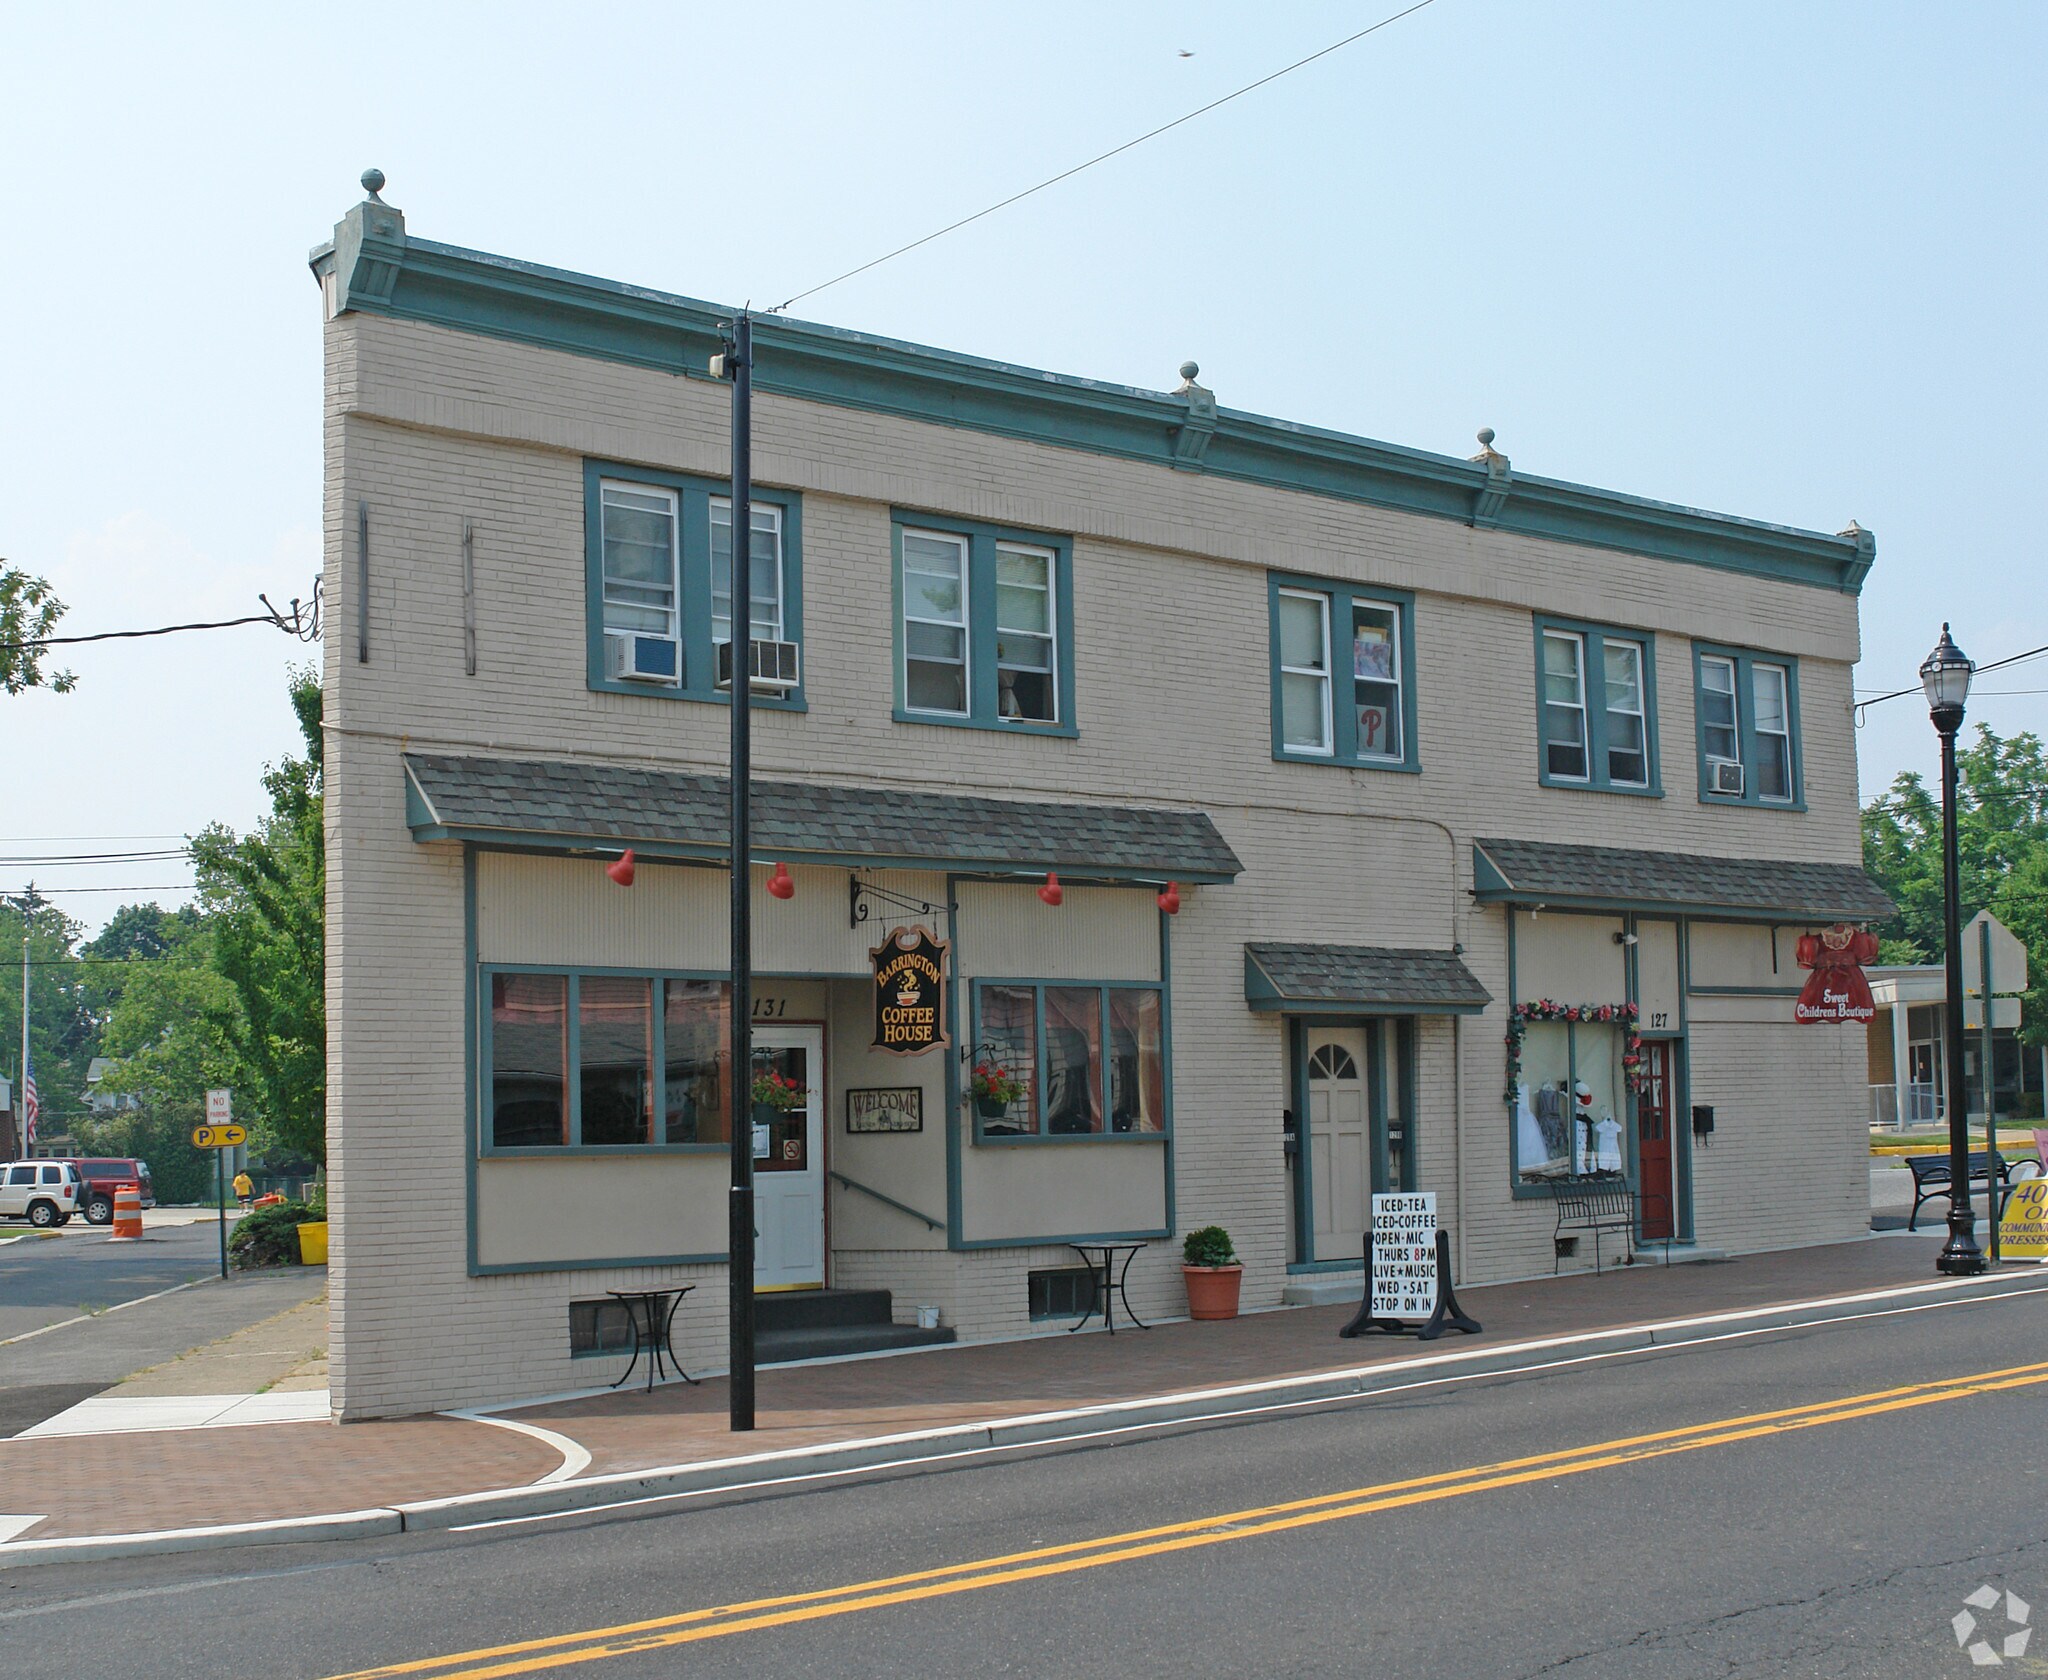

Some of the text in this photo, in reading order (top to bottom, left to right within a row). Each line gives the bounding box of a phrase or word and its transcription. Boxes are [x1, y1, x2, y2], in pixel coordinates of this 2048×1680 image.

[877, 953, 941, 989] BARRINGTON
[1823, 988, 1849, 1003] Sweet
[752, 998, 786, 1017] 131
[882, 1006, 935, 1024] COFFEE
[1797, 1003, 1874, 1020] Childrens Boutique
[1651, 1013, 1667, 1028] 127
[884, 1024, 933, 1043] HOUSE
[213, 1097, 224, 1105] NO
[853, 1092, 918, 1120] WELCOME
[199, 1130, 209, 1143] P
[2016, 1184, 2047, 1204] 40
[1381, 1198, 1427, 1212] ICED-TEA
[1373, 1214, 1436, 1229] ICED-COFFEE
[1378, 1248, 1410, 1261] THURS
[1378, 1281, 1429, 1295] WED SAT
[1373, 1297, 1432, 1311] STOP ON IN
